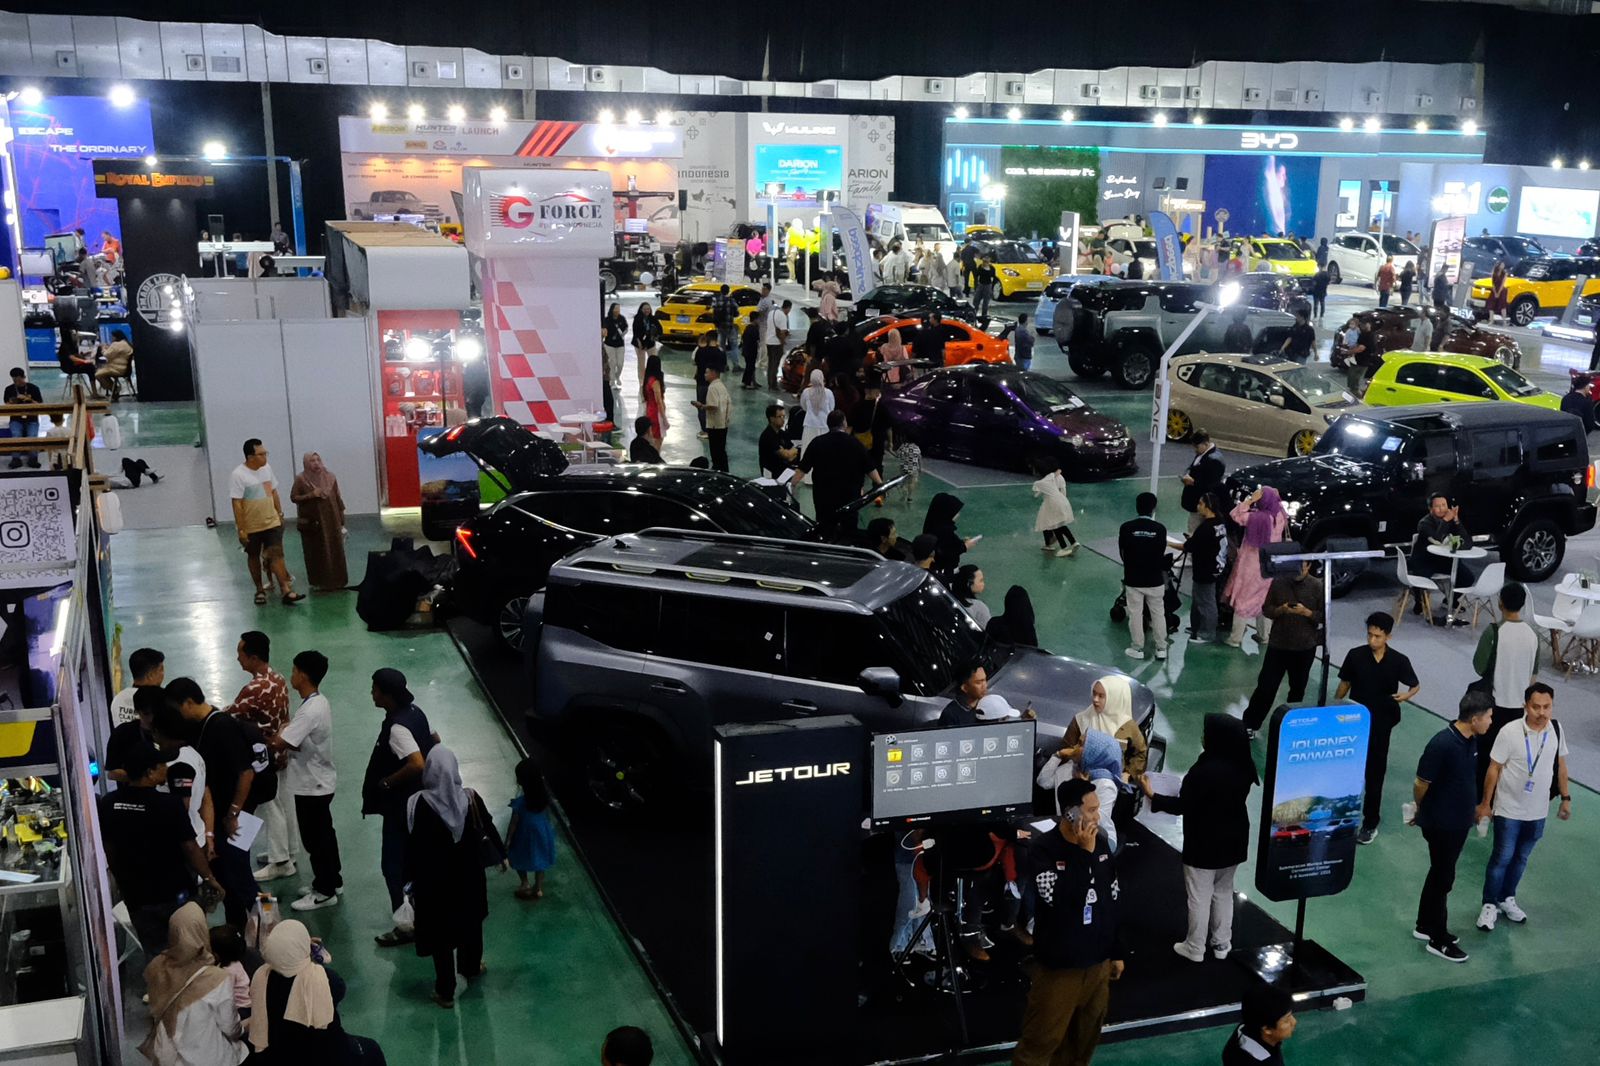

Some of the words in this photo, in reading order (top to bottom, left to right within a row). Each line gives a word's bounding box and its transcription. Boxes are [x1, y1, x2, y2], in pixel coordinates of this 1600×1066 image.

[18, 127, 73, 135] ESCAPE
[462, 128, 499, 136] LAUNCH
[1241, 132, 1299, 148] BYD
[50, 144, 77, 152] THE
[79, 145, 147, 153] ORDINARY
[777, 159, 819, 169] DARION
[847, 169, 889, 178] ARION
[497, 195, 535, 229] G
[539, 204, 603, 219] FORCE
[1292, 735, 1358, 749] JOURNEY
[1288, 748, 1355, 762] ONWARD
[735, 762, 851, 785] JETOUR
